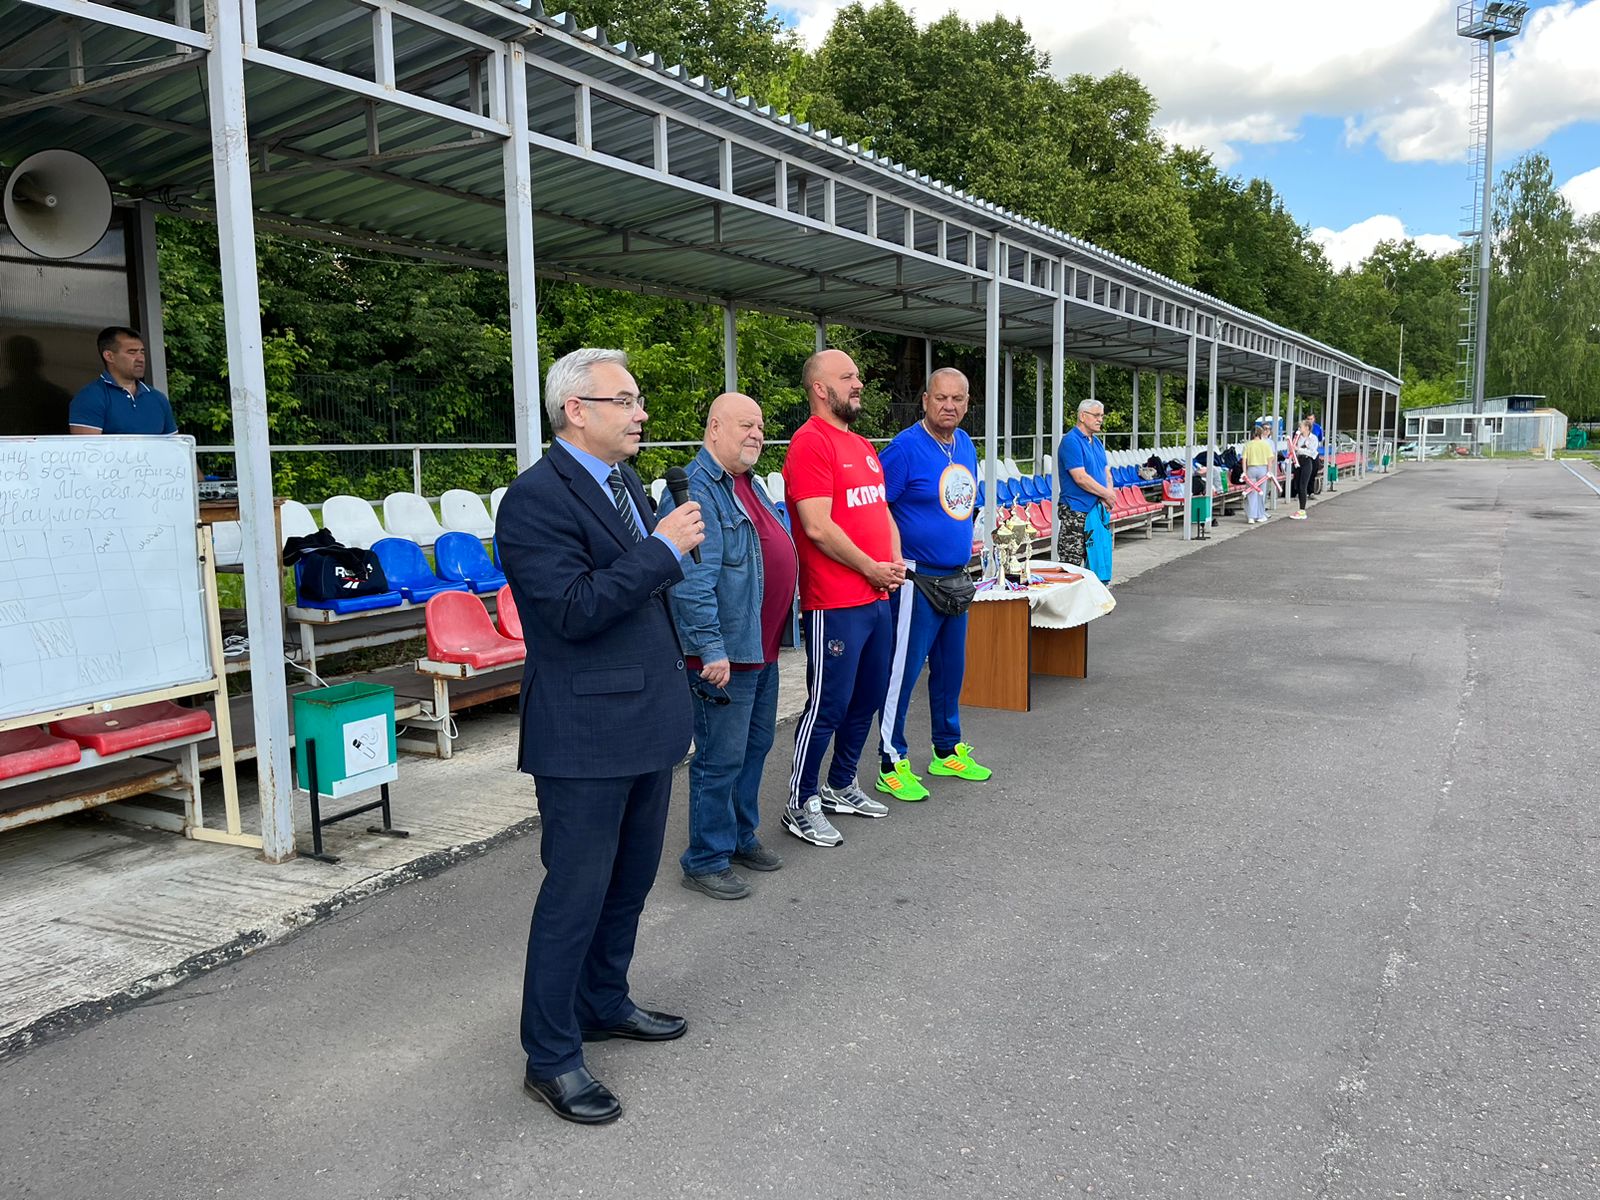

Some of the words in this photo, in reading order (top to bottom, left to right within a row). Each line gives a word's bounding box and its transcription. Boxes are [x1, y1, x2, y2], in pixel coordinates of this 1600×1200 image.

[0, 462, 29, 480] ов
[97, 468, 126, 480] на
[14, 535, 27, 556] 4
[62, 535, 74, 550] 5
